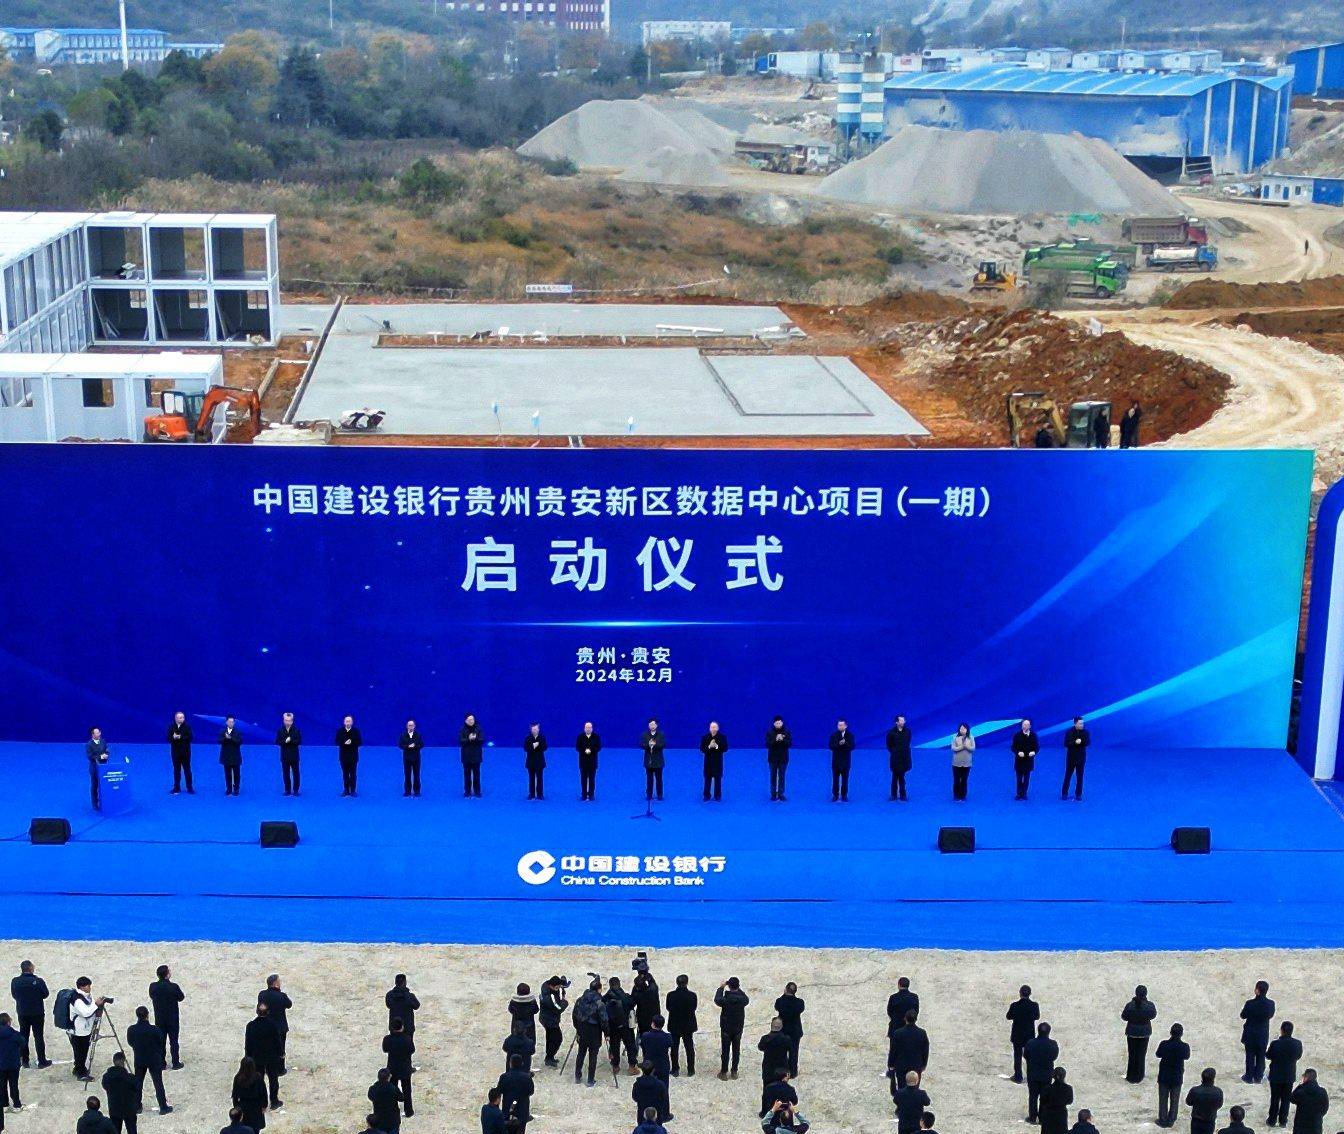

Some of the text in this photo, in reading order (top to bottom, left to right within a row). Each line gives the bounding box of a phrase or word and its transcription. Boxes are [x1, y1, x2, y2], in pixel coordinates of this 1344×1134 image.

[461, 536, 784, 592] 启动仪式
[575, 668, 672, 684] 2024年12月
[560, 855, 727, 873] 中国建设银行
[560, 875, 706, 886] China Construction Bank
